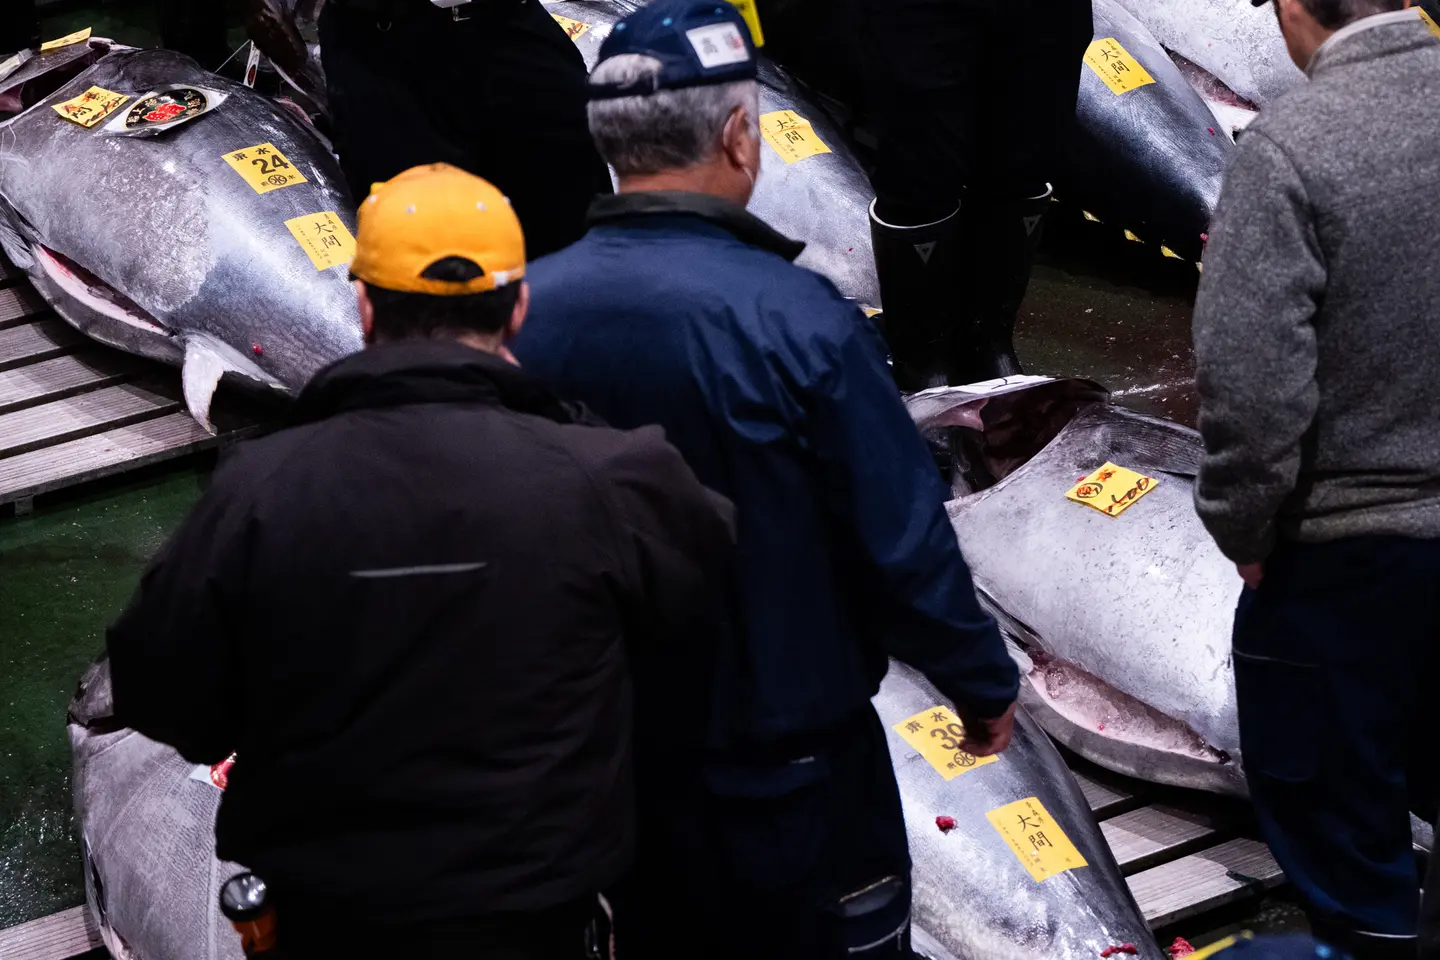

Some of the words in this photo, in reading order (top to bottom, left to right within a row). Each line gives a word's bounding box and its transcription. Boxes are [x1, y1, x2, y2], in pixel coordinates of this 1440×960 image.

[1100, 48, 1130, 75] 大間
[776, 119, 805, 144] 大間
[251, 154, 289, 175] 24
[314, 221, 342, 249] 大間
[905, 711, 948, 734] 東水
[1016, 814, 1053, 852] 大間
